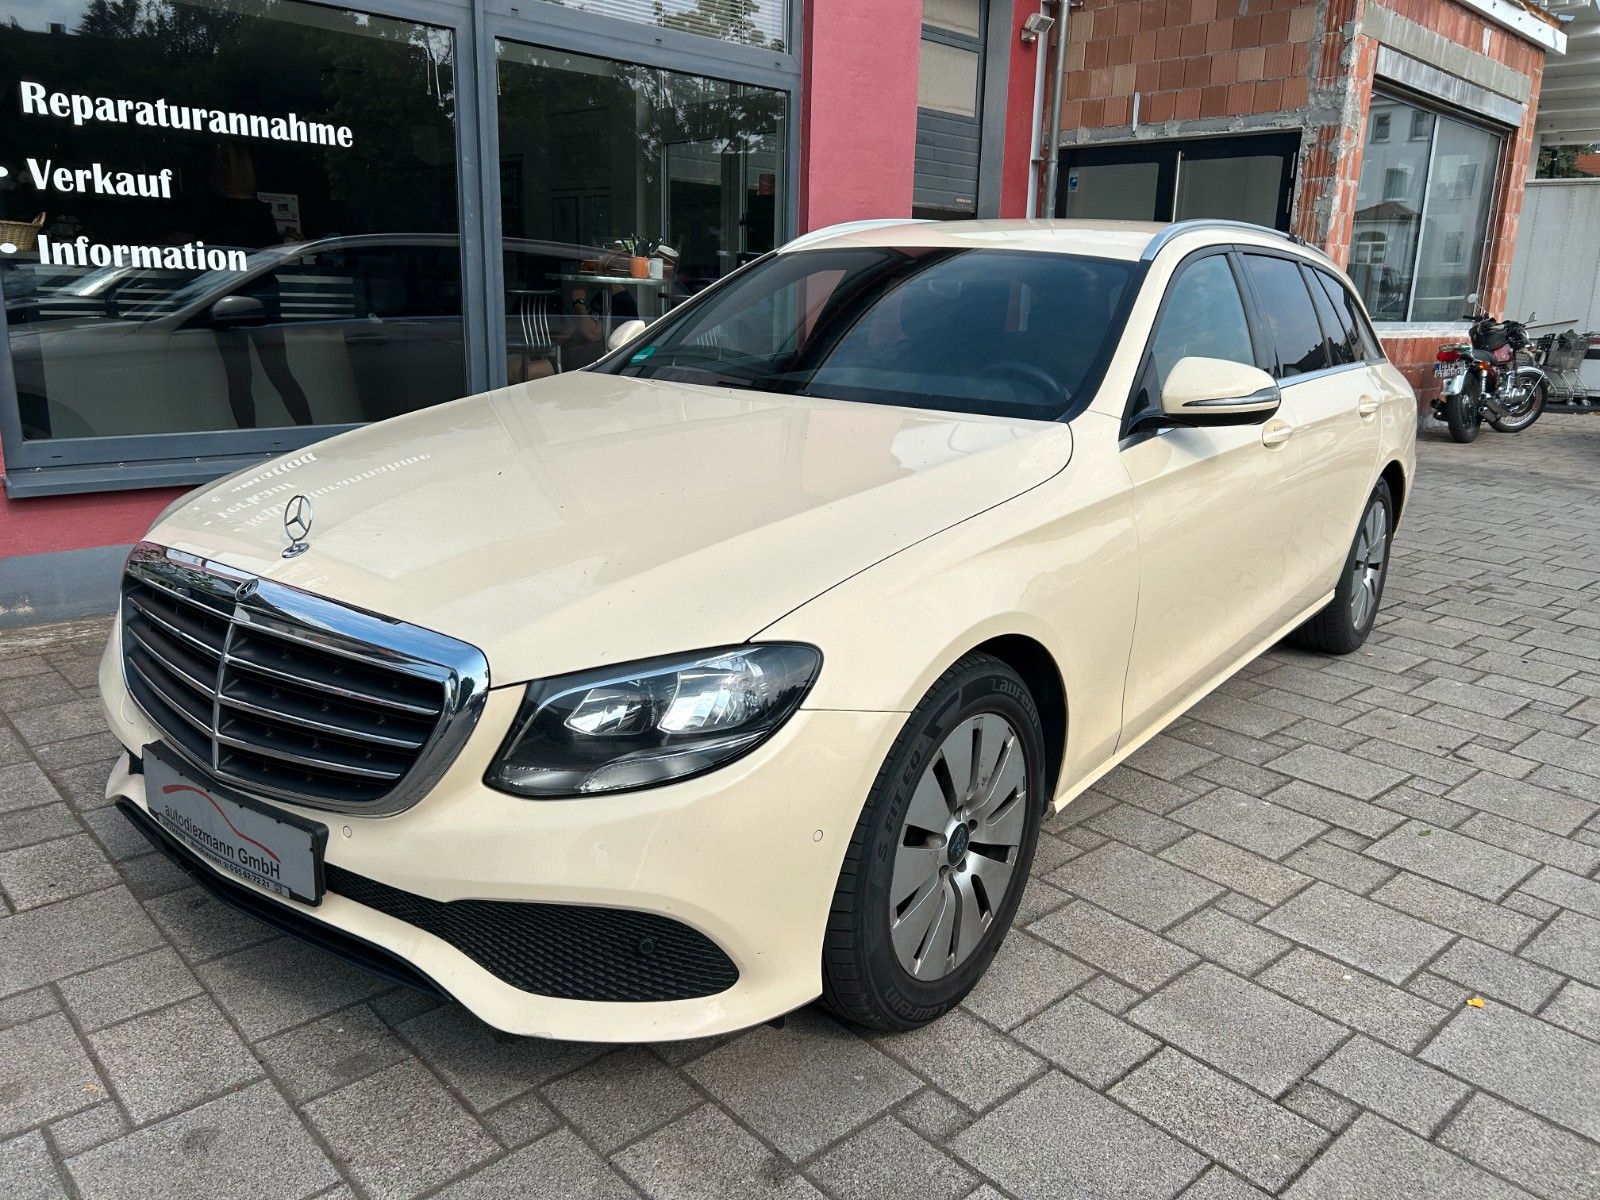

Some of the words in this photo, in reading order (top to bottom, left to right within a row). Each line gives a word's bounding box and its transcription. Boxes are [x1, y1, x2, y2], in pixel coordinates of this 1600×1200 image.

[20, 81, 353, 147] Reparaturannahme
[26, 158, 173, 198] Verkauf
[37, 235, 248, 271] Information
[164, 805, 234, 858] autodiezmann
[238, 847, 281, 880] GmbH
